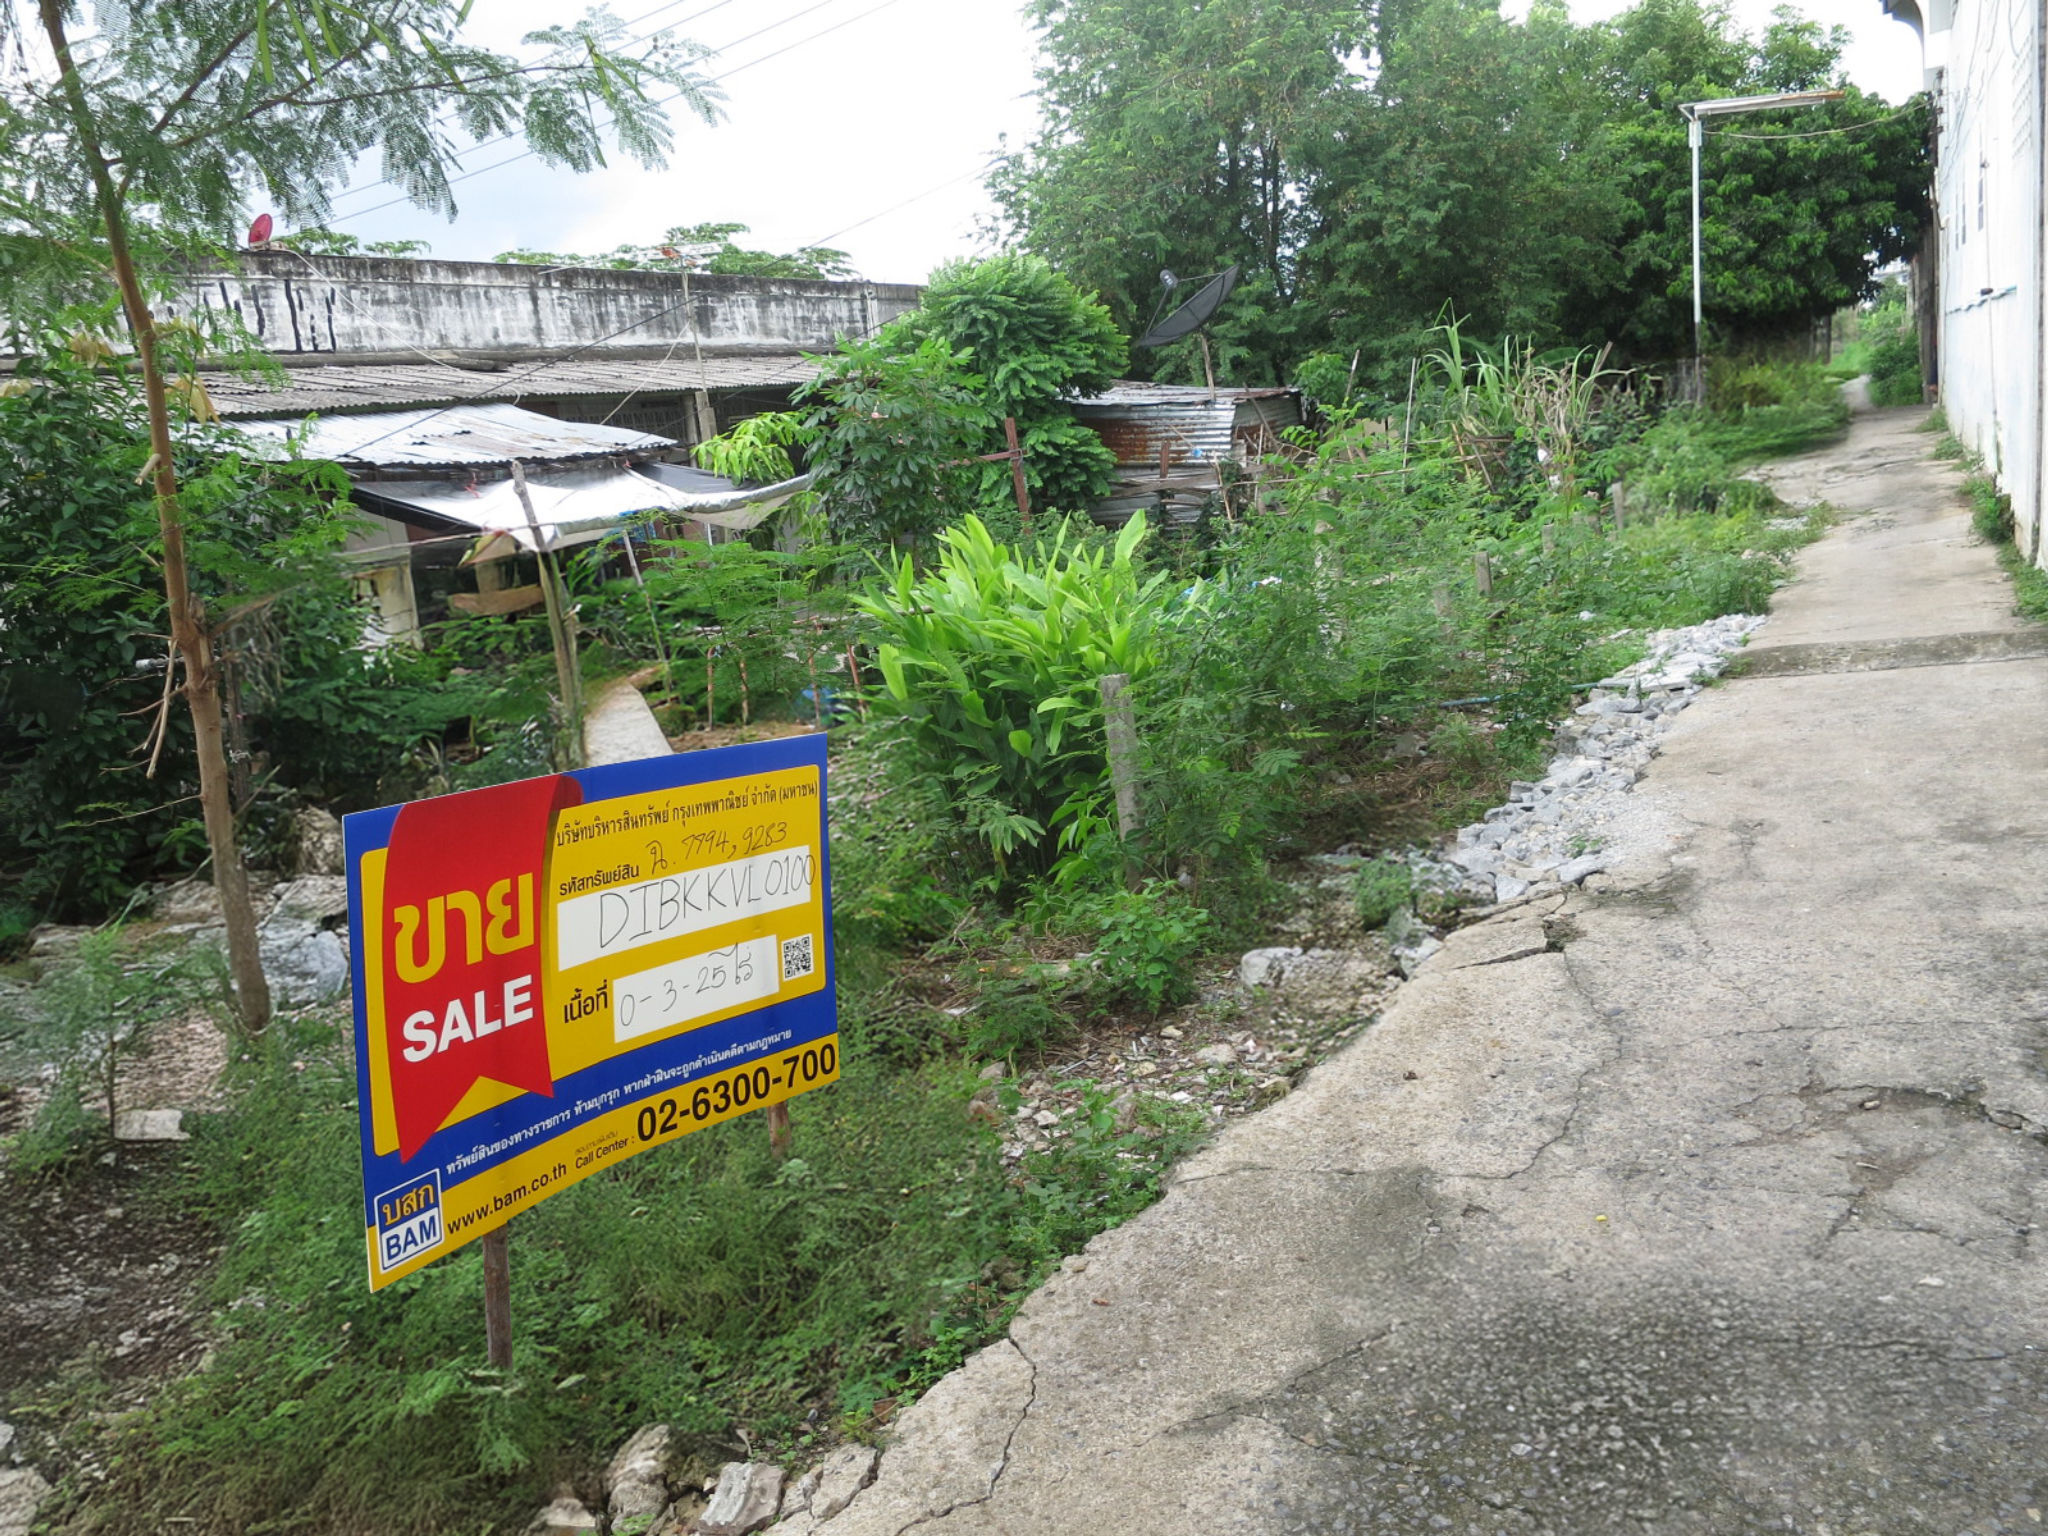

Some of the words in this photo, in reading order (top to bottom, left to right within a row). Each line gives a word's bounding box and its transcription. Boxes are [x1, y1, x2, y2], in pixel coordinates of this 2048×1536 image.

[557, 800, 670, 847] บริษัทบริหารสินทรัพย์
[672, 785, 749, 828] กรุงเทพพาณิชย์
[751, 783, 777, 806] จำกัด
[779, 780, 818, 804] (มหาชน)
[559, 863, 640, 896] รหัสทรัพย์สิน
[393, 872, 534, 984] ขาย
[402, 974, 534, 1063] SALE
[563, 979, 608, 1024] เนื้อที่
[446, 1108, 571, 1175] ทรัพย์สินของทางราชการ
[574, 1088, 620, 1117] ห้ามบุกรุก
[623, 1029, 792, 1094] หากฝ่าฝืนจะถูกดำเนินคดีตามกฎหมาย
[637, 1043, 836, 1142] 02-6300-700
[575, 1150, 594, 1169] Call
[596, 1137, 629, 1159] Center
[382, 1183, 434, 1227] บสก
[446, 1163, 567, 1235] www.bam.co.th
[386, 1214, 438, 1261] BAM
